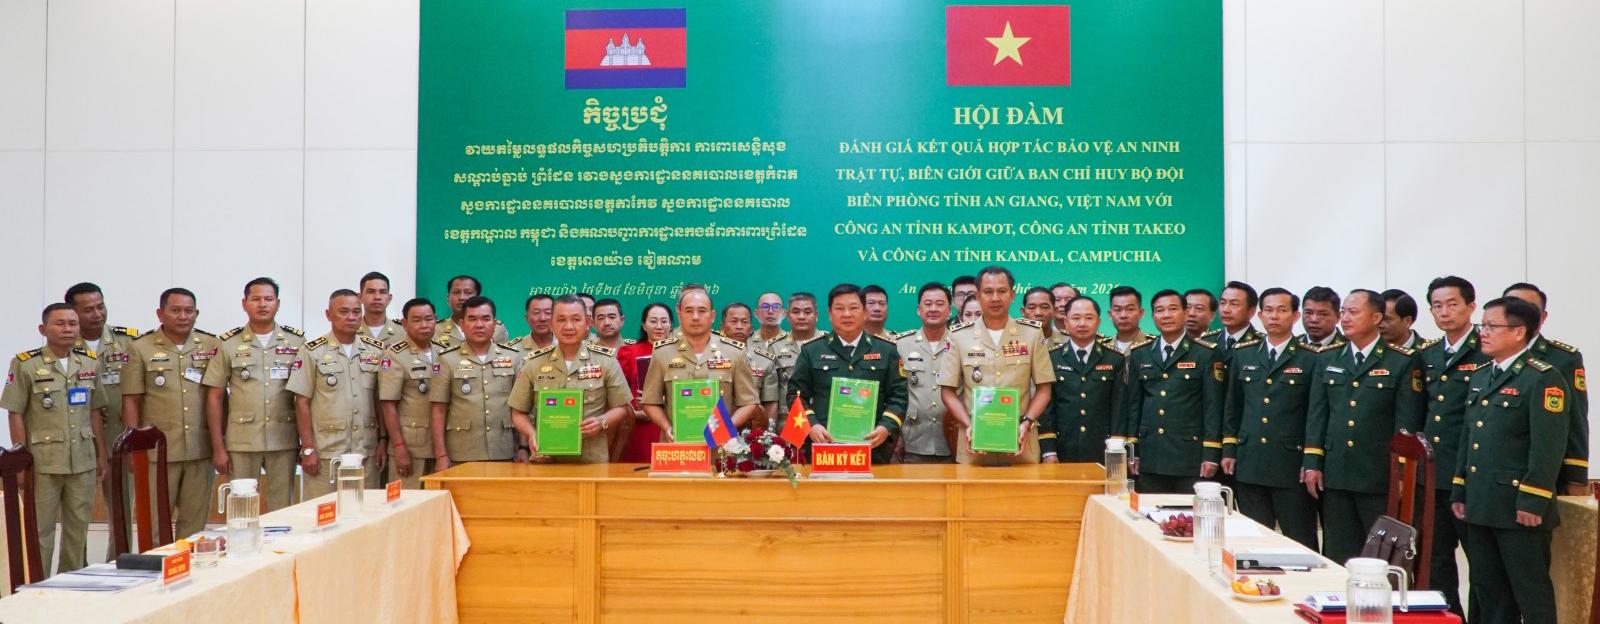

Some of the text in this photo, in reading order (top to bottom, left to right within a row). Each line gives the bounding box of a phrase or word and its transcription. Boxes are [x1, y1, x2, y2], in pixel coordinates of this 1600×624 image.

[583, 95, 668, 132] កិច្ចប្រជុំ
[953, 101, 1064, 130] HỘI ĐÀM
[839, 138, 1180, 156] ĐÁNH GIÁ KẾT QUẢ HỢP TÁC BẢO VỆ AN NINH
[835, 165, 1184, 183] TRẬT TỰ, BIÊN GIỚI GIỮA BAN CHỈ HUY BỘ ĐỘI
[847, 192, 1174, 210] BIÊN PHÒNG TỈNH AN GIANG, VIỆT NAM VỚI
[834, 220, 1186, 237] CÔNG AN TỈNH KAMPOT, CÔNG AN TỈNH TAKEO
[858, 247, 1162, 264] VÀ CÔNG AN TỈNH KANDAL, CAMPUCHIA
[898, 283, 916, 294] An
